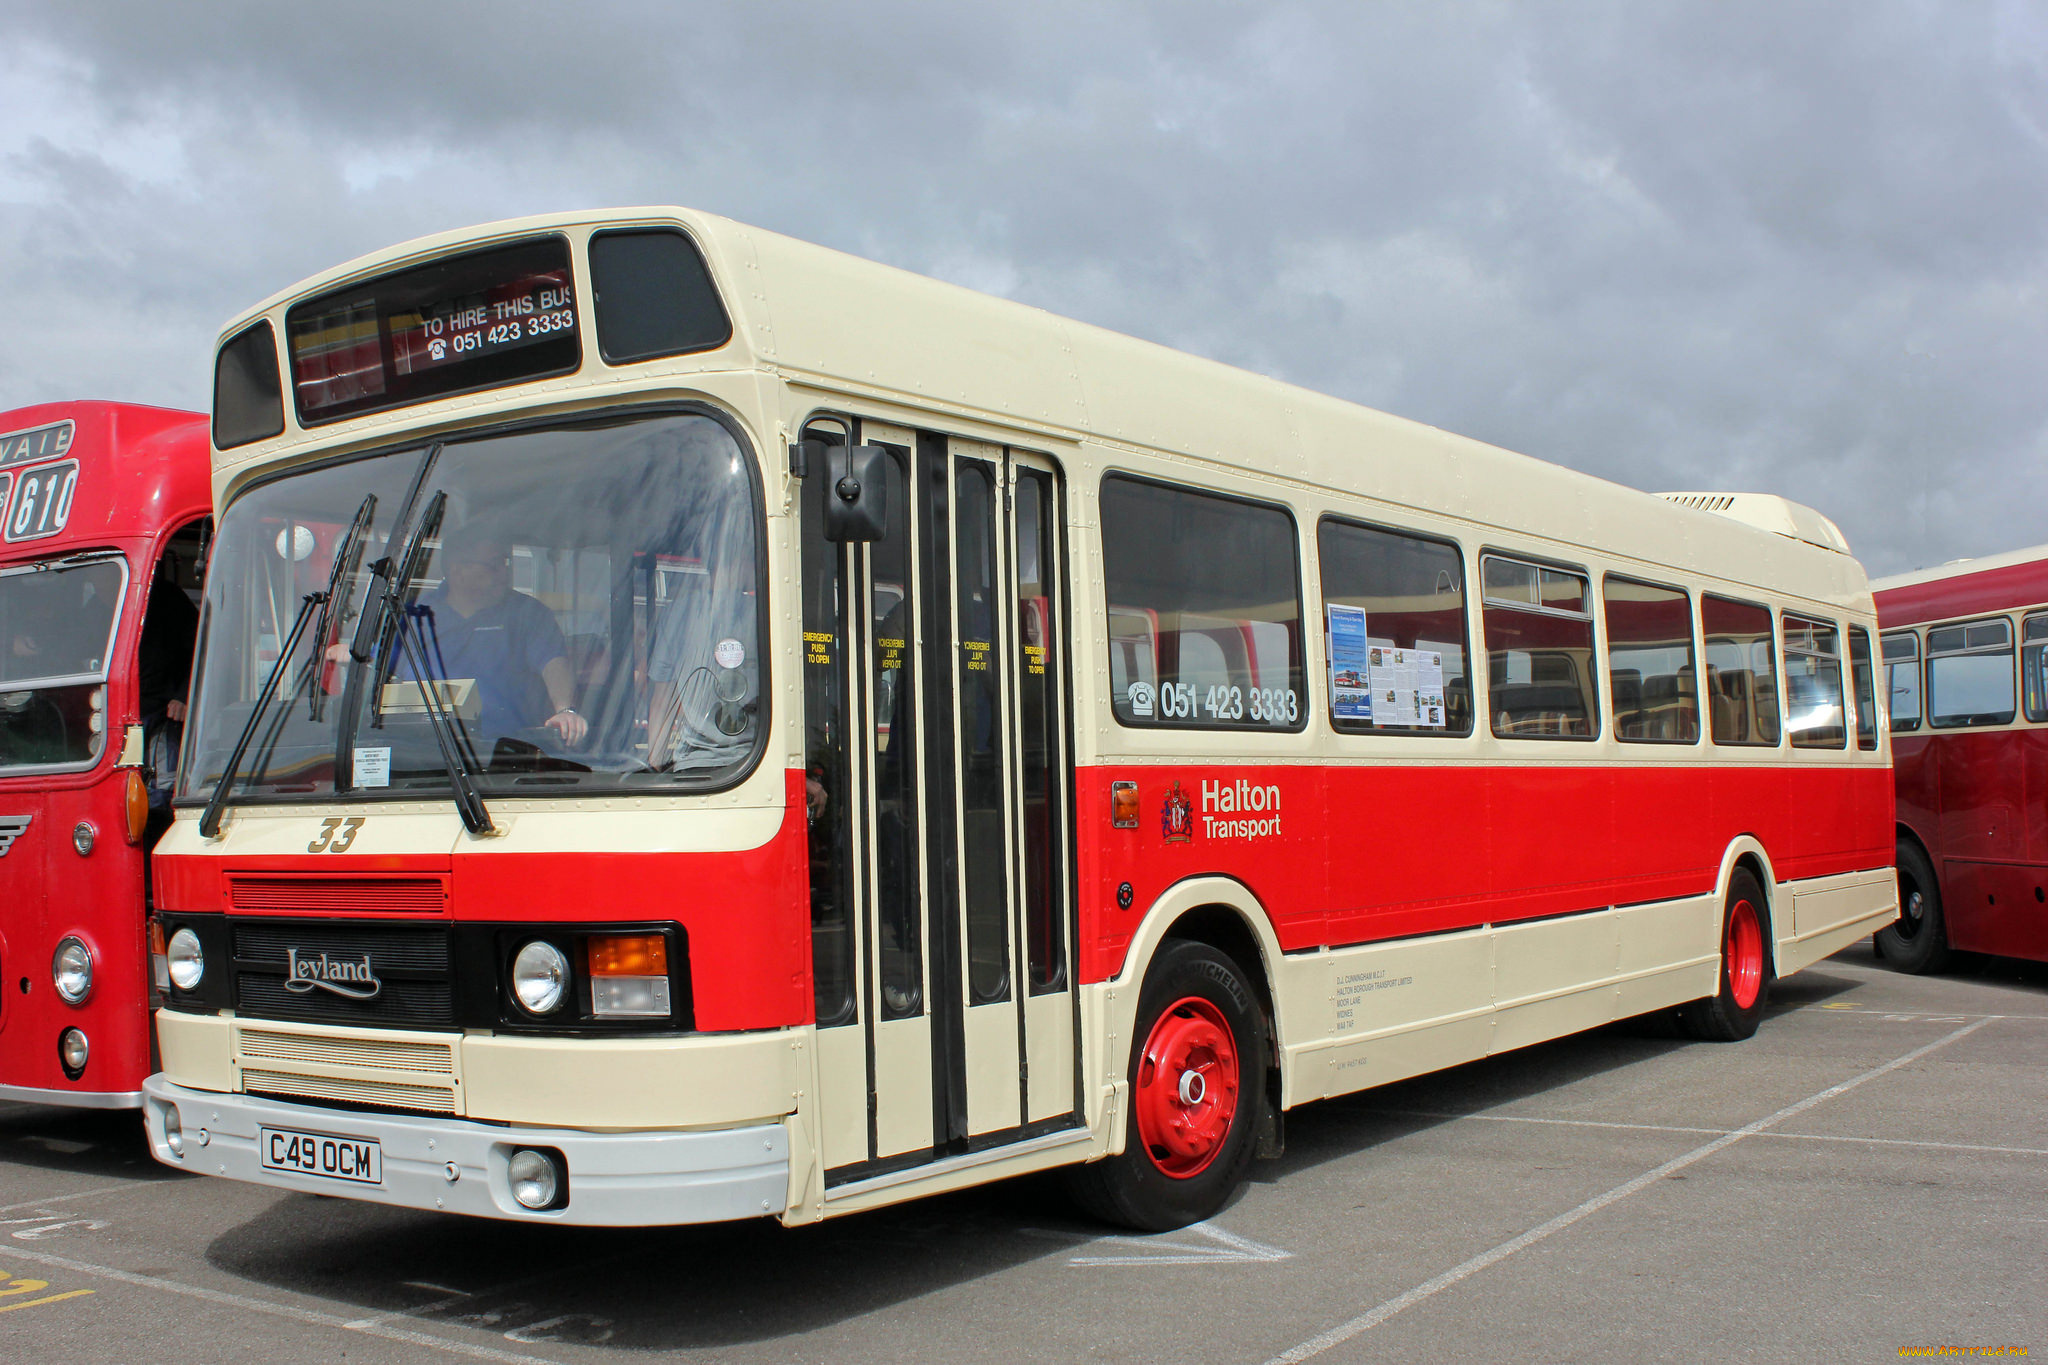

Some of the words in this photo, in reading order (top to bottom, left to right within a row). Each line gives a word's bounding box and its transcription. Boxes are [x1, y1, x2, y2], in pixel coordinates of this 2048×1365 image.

[422, 317, 444, 337] TO
[450, 306, 488, 331] HIRE
[493, 295, 534, 319] THIS
[453, 330, 482, 352] 051
[488, 322, 521, 344] 423
[528, 310, 573, 335] 3333
[15, 469, 78, 534] 610
[803, 632, 833, 642] EMERGENCY
[811, 643, 826, 653] PUSH
[808, 654, 815, 663] TO
[816, 654, 830, 664] OPEN
[1161, 681, 1198, 718] 051
[1205, 685, 1243, 720] 423
[1249, 687, 1298, 722] 3333
[1202, 779, 1281, 813] Halton
[308, 817, 366, 853] 33
[1202, 814, 1282, 841] Transport
[285, 949, 380, 998] Leyland
[1336, 986, 1353, 995] HALTON
[1354, 983, 1374, 993] BOROUGH
[1374, 979, 1397, 989] TRANSPORT
[271, 1133, 315, 1169] C49
[323, 1141, 370, 1177] OCM
